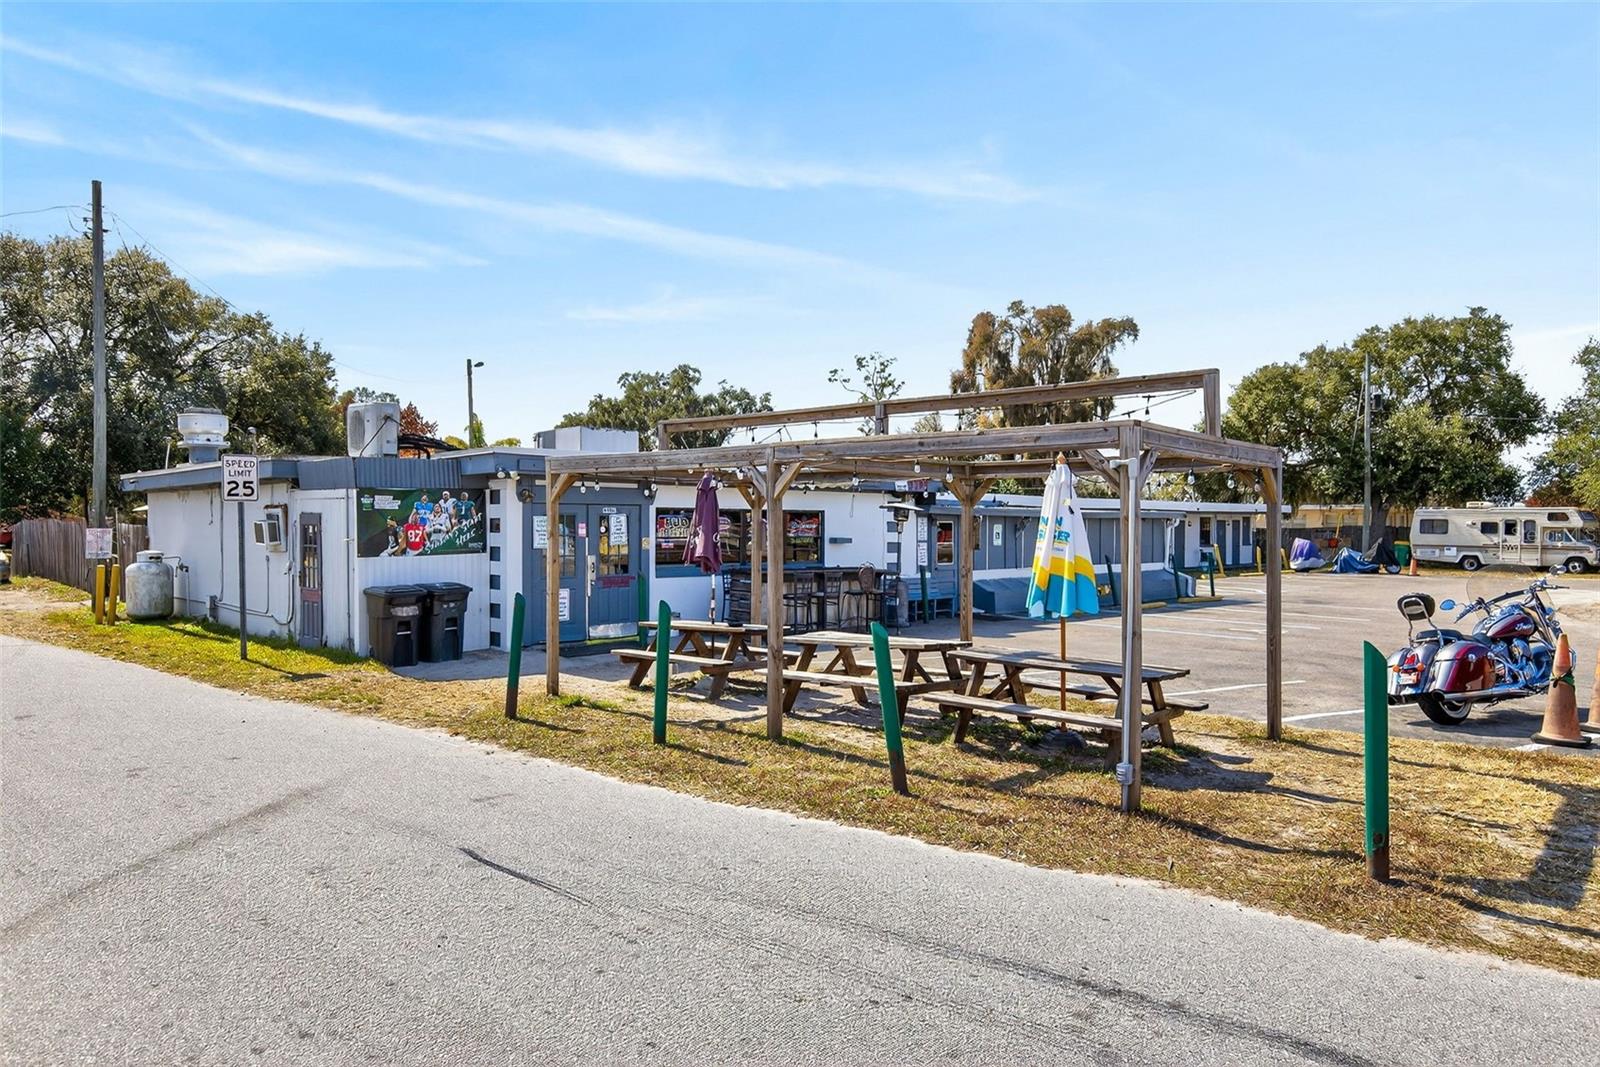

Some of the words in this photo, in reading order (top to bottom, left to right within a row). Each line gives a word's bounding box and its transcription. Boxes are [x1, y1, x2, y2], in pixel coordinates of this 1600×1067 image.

[225, 460, 256, 468] SPEED
[228, 469, 253, 477] LIMIT
[227, 480, 255, 497] 25
[407, 529, 423, 542] 87
